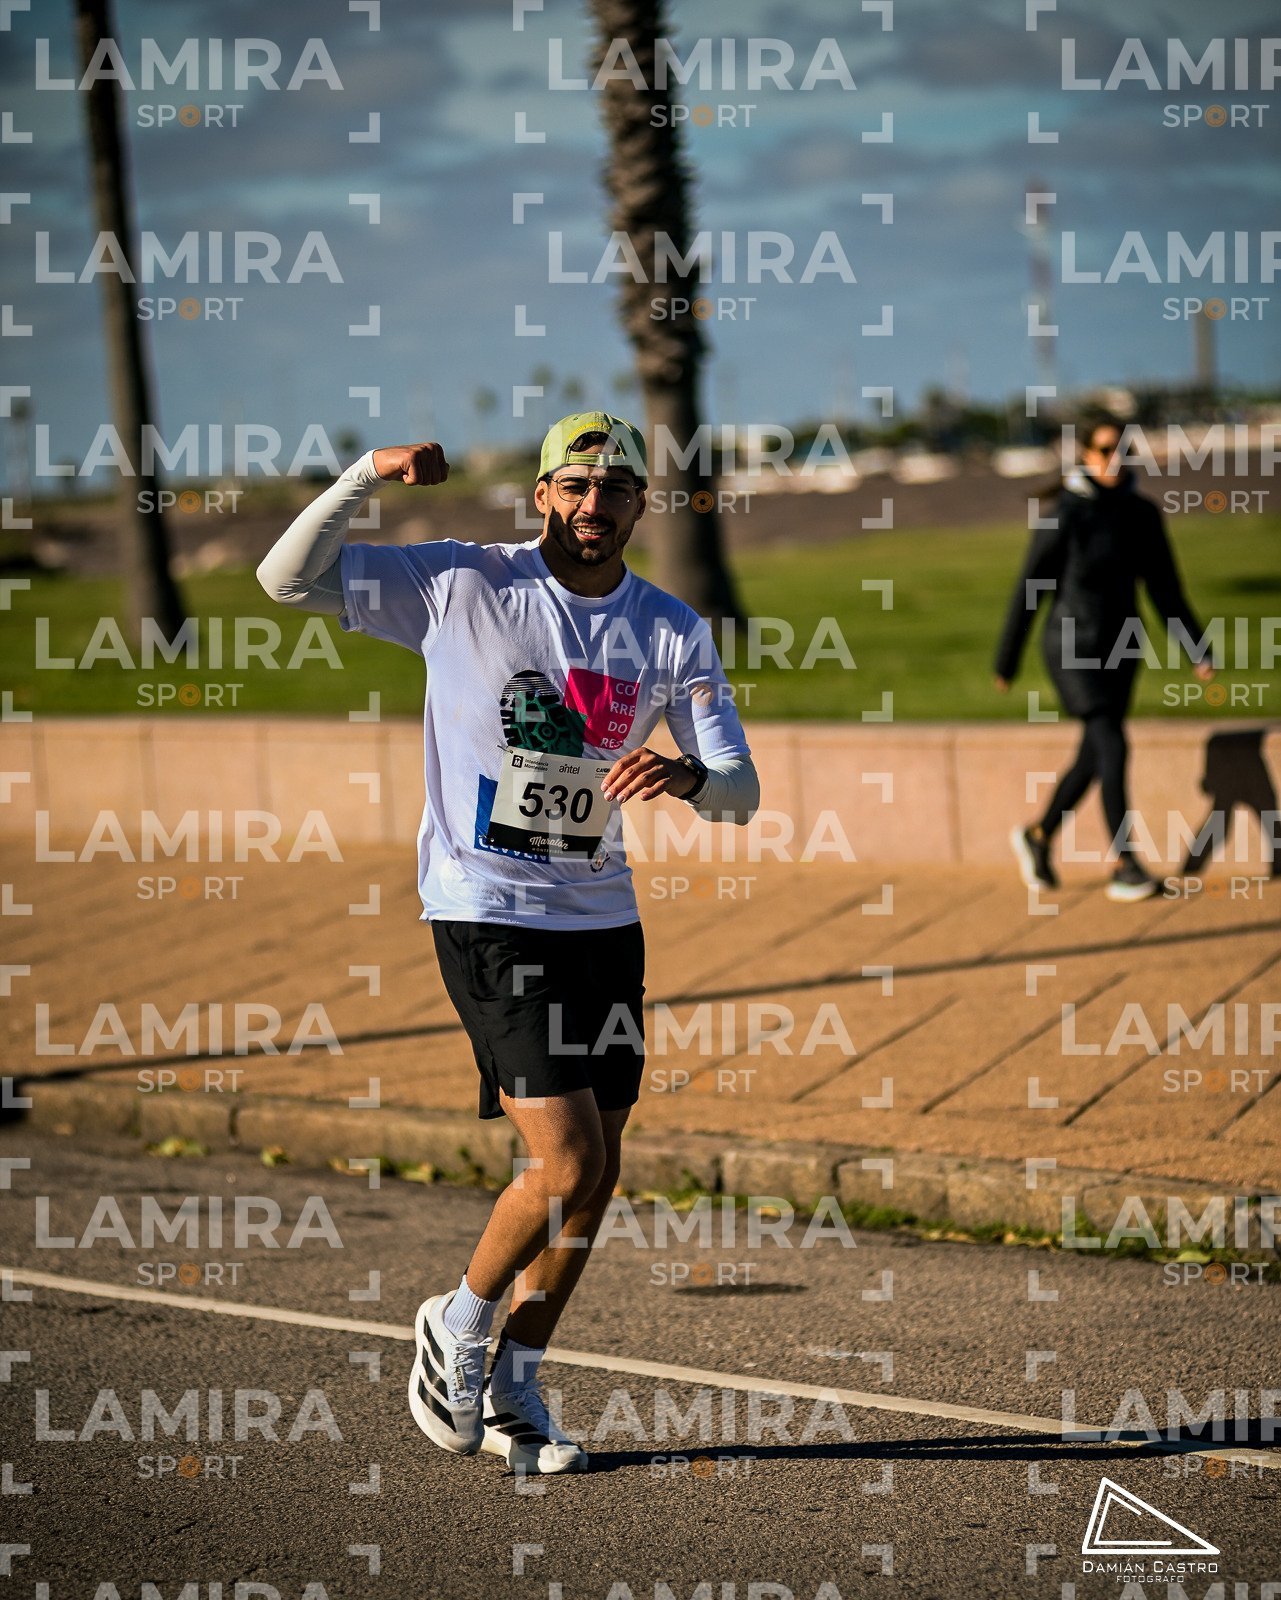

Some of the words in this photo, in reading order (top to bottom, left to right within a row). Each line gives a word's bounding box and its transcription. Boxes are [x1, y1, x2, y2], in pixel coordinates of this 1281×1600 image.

[610, 701, 636, 717] RRE
[608, 721, 628, 734] DO
[519, 781, 594, 824] 530
